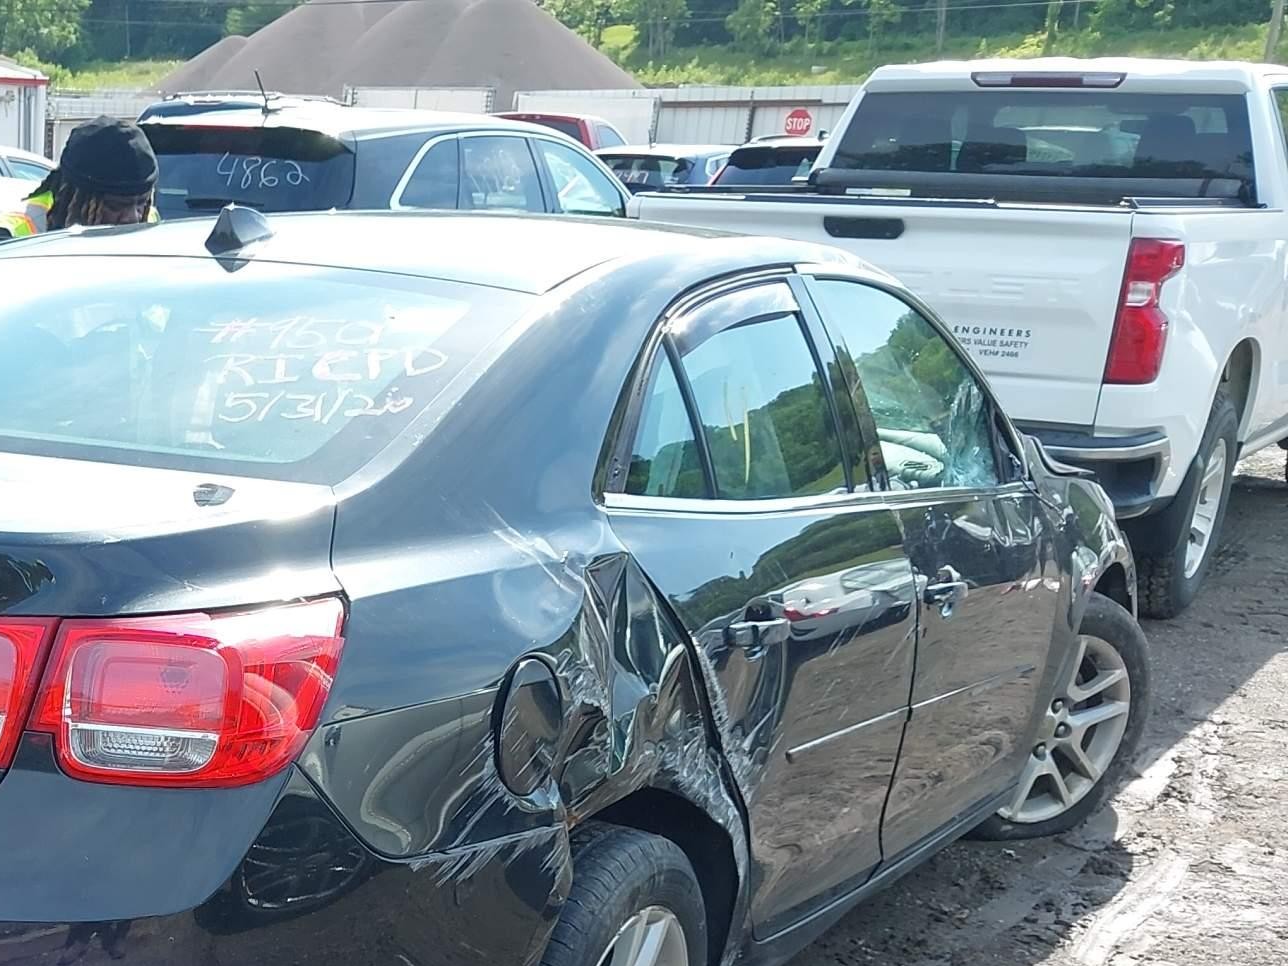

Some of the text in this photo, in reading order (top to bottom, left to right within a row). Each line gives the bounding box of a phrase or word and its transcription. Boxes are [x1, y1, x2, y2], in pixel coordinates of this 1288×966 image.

[786, 117, 811, 130] STOP
[217, 151, 311, 189] 4862
[953, 325, 1032, 338] ENGINEERS
[973, 338, 998, 348] VALUE
[999, 339, 1030, 350] SAFETY
